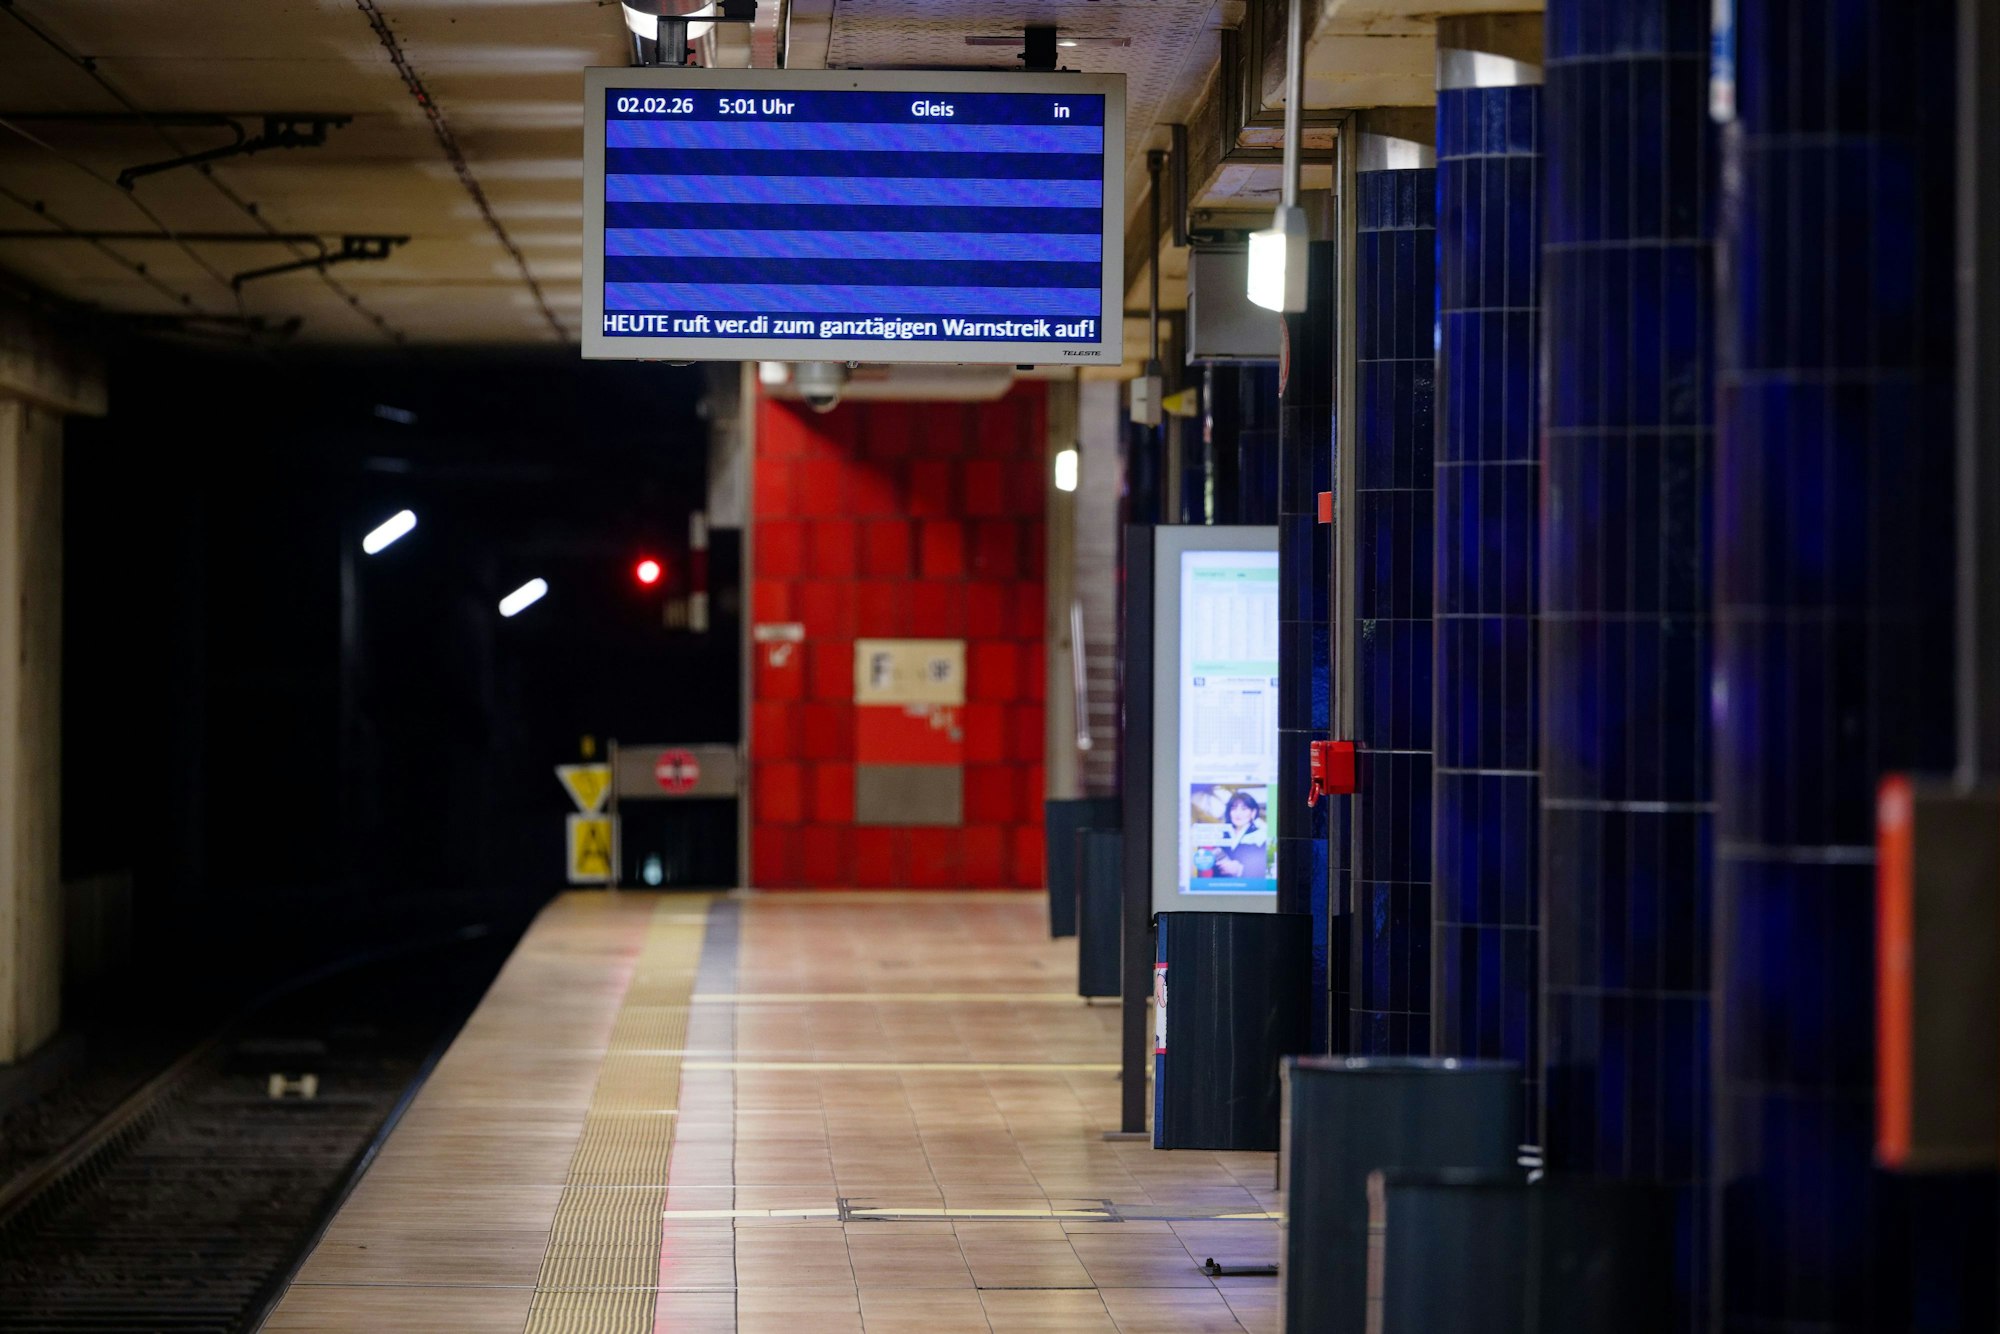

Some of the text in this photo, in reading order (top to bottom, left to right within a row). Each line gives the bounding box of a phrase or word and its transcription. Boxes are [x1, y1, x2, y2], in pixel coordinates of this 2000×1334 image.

[617, 97, 1070, 118] 02.02.26 5:01 Uhr Gleis in
[603, 314, 1095, 340] HEUTE ruft ver.di zum ganztägigen Warnstreik auf!
